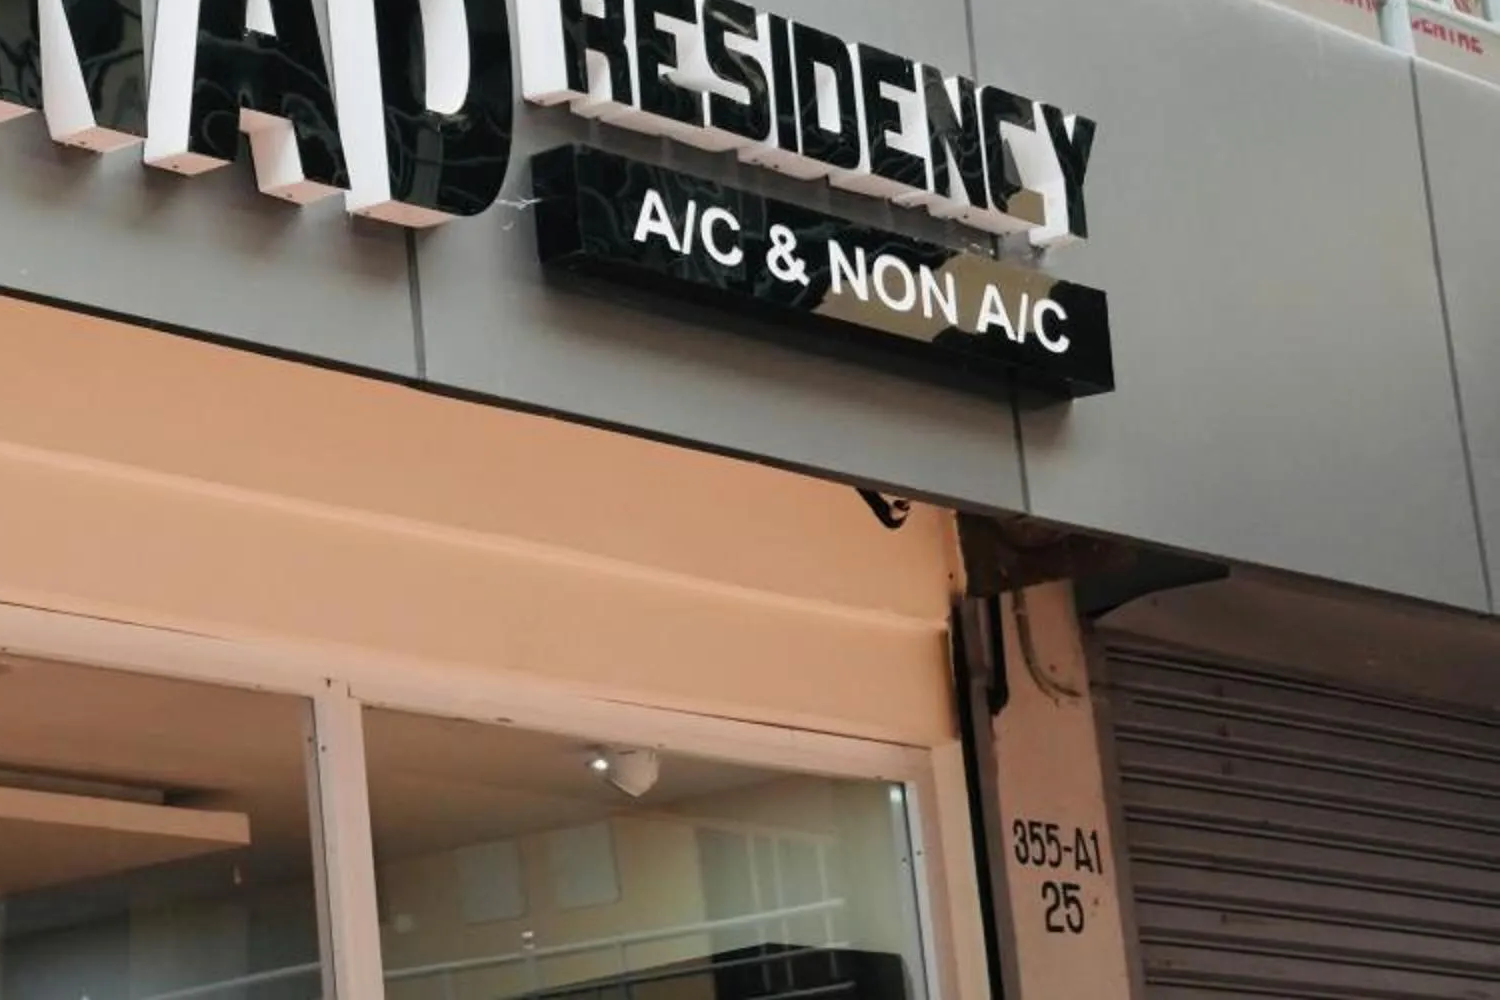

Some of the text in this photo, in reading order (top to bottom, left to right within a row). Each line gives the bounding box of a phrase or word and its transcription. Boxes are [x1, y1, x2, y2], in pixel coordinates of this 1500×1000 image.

[633, 188, 1071, 354] A/C & NON A/C
[1012, 818, 1103, 875] 355-A1
[1041, 881, 1085, 935] 25
